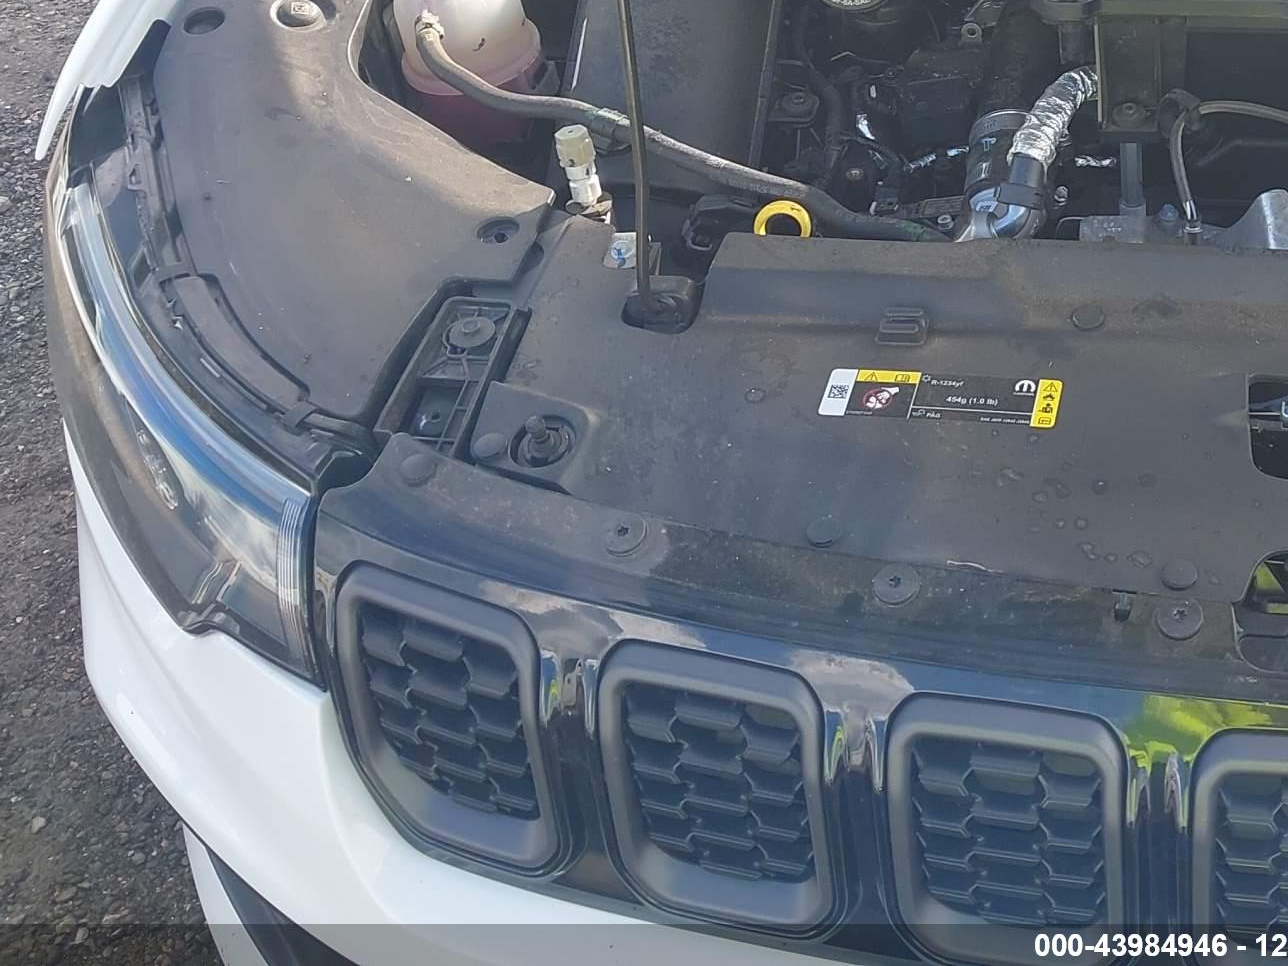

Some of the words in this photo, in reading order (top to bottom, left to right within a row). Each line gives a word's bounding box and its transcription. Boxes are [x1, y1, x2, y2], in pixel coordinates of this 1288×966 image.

[931, 379, 964, 388] R-1234yf
[945, 395, 967, 406] 454g
[968, 396, 985, 406] (1.0
[986, 397, 999, 407] lb)
